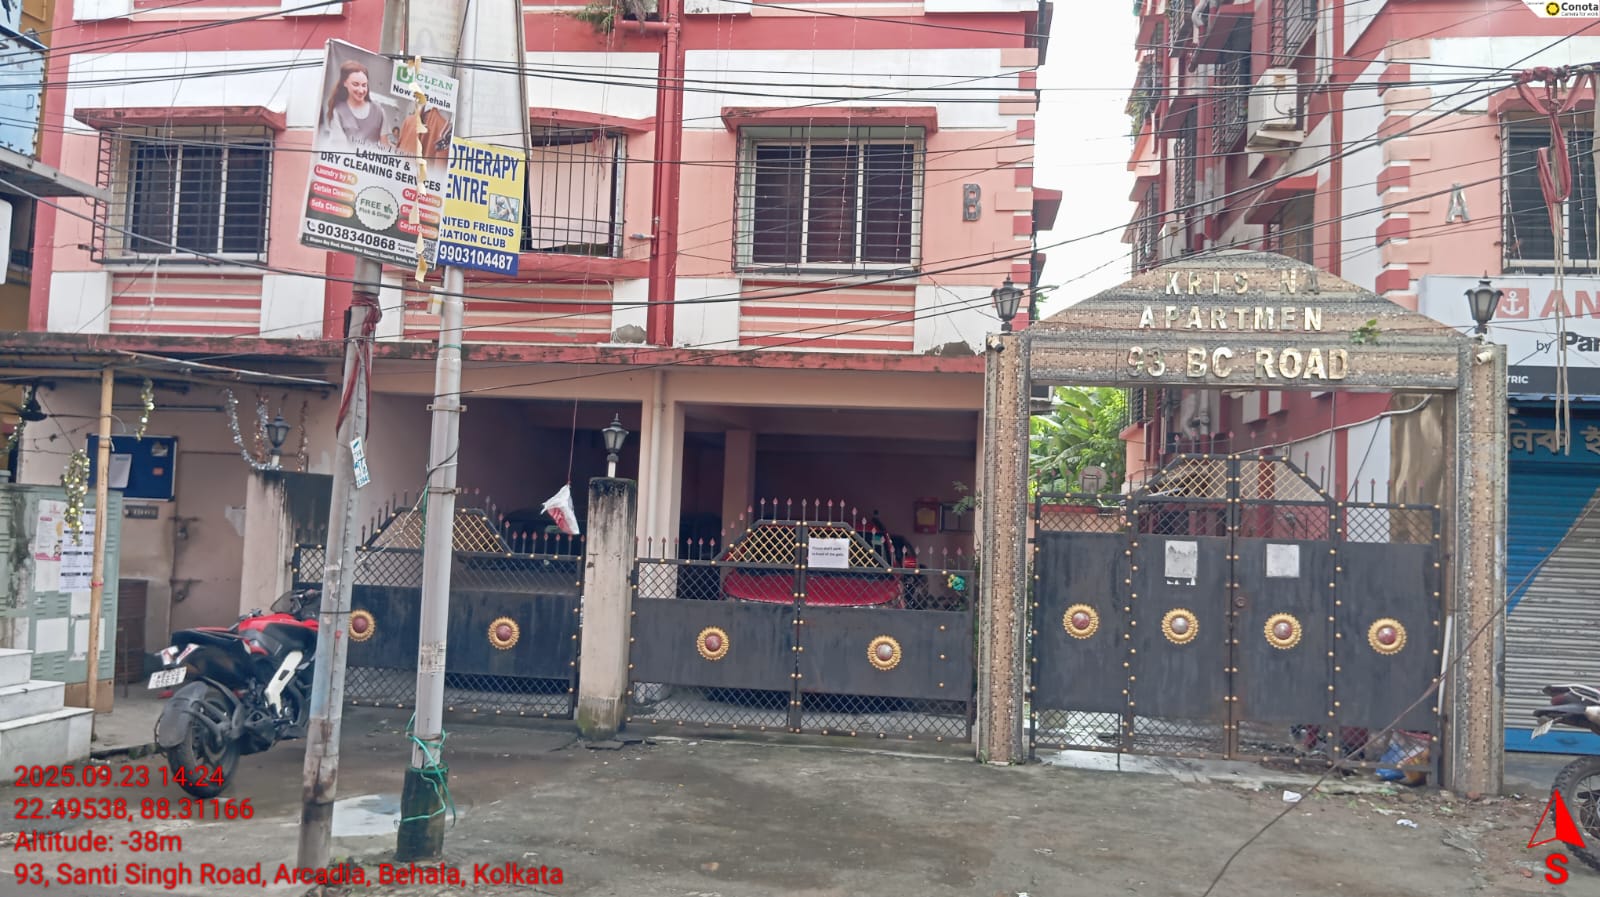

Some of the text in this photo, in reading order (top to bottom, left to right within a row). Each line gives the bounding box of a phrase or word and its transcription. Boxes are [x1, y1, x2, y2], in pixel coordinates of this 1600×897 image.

[393, 83, 412, 96] Now
[416, 73, 453, 91] CLEAN
[320, 151, 441, 192] DRY CLEANING SERVCES
[355, 147, 402, 169] LAUNDRY
[403, 161, 412, 172] &
[360, 198, 382, 210] FREE
[962, 183, 982, 222] B
[1446, 183, 1471, 224] A
[317, 222, 396, 251] 9038340868
[440, 228, 506, 249] IATION CLUB
[473, 221, 514, 238] FRIENDS
[439, 244, 514, 272] 9903104487
[1536, 339, 1552, 354] by
[1126, 346, 1350, 381] 93 BC ROAD
